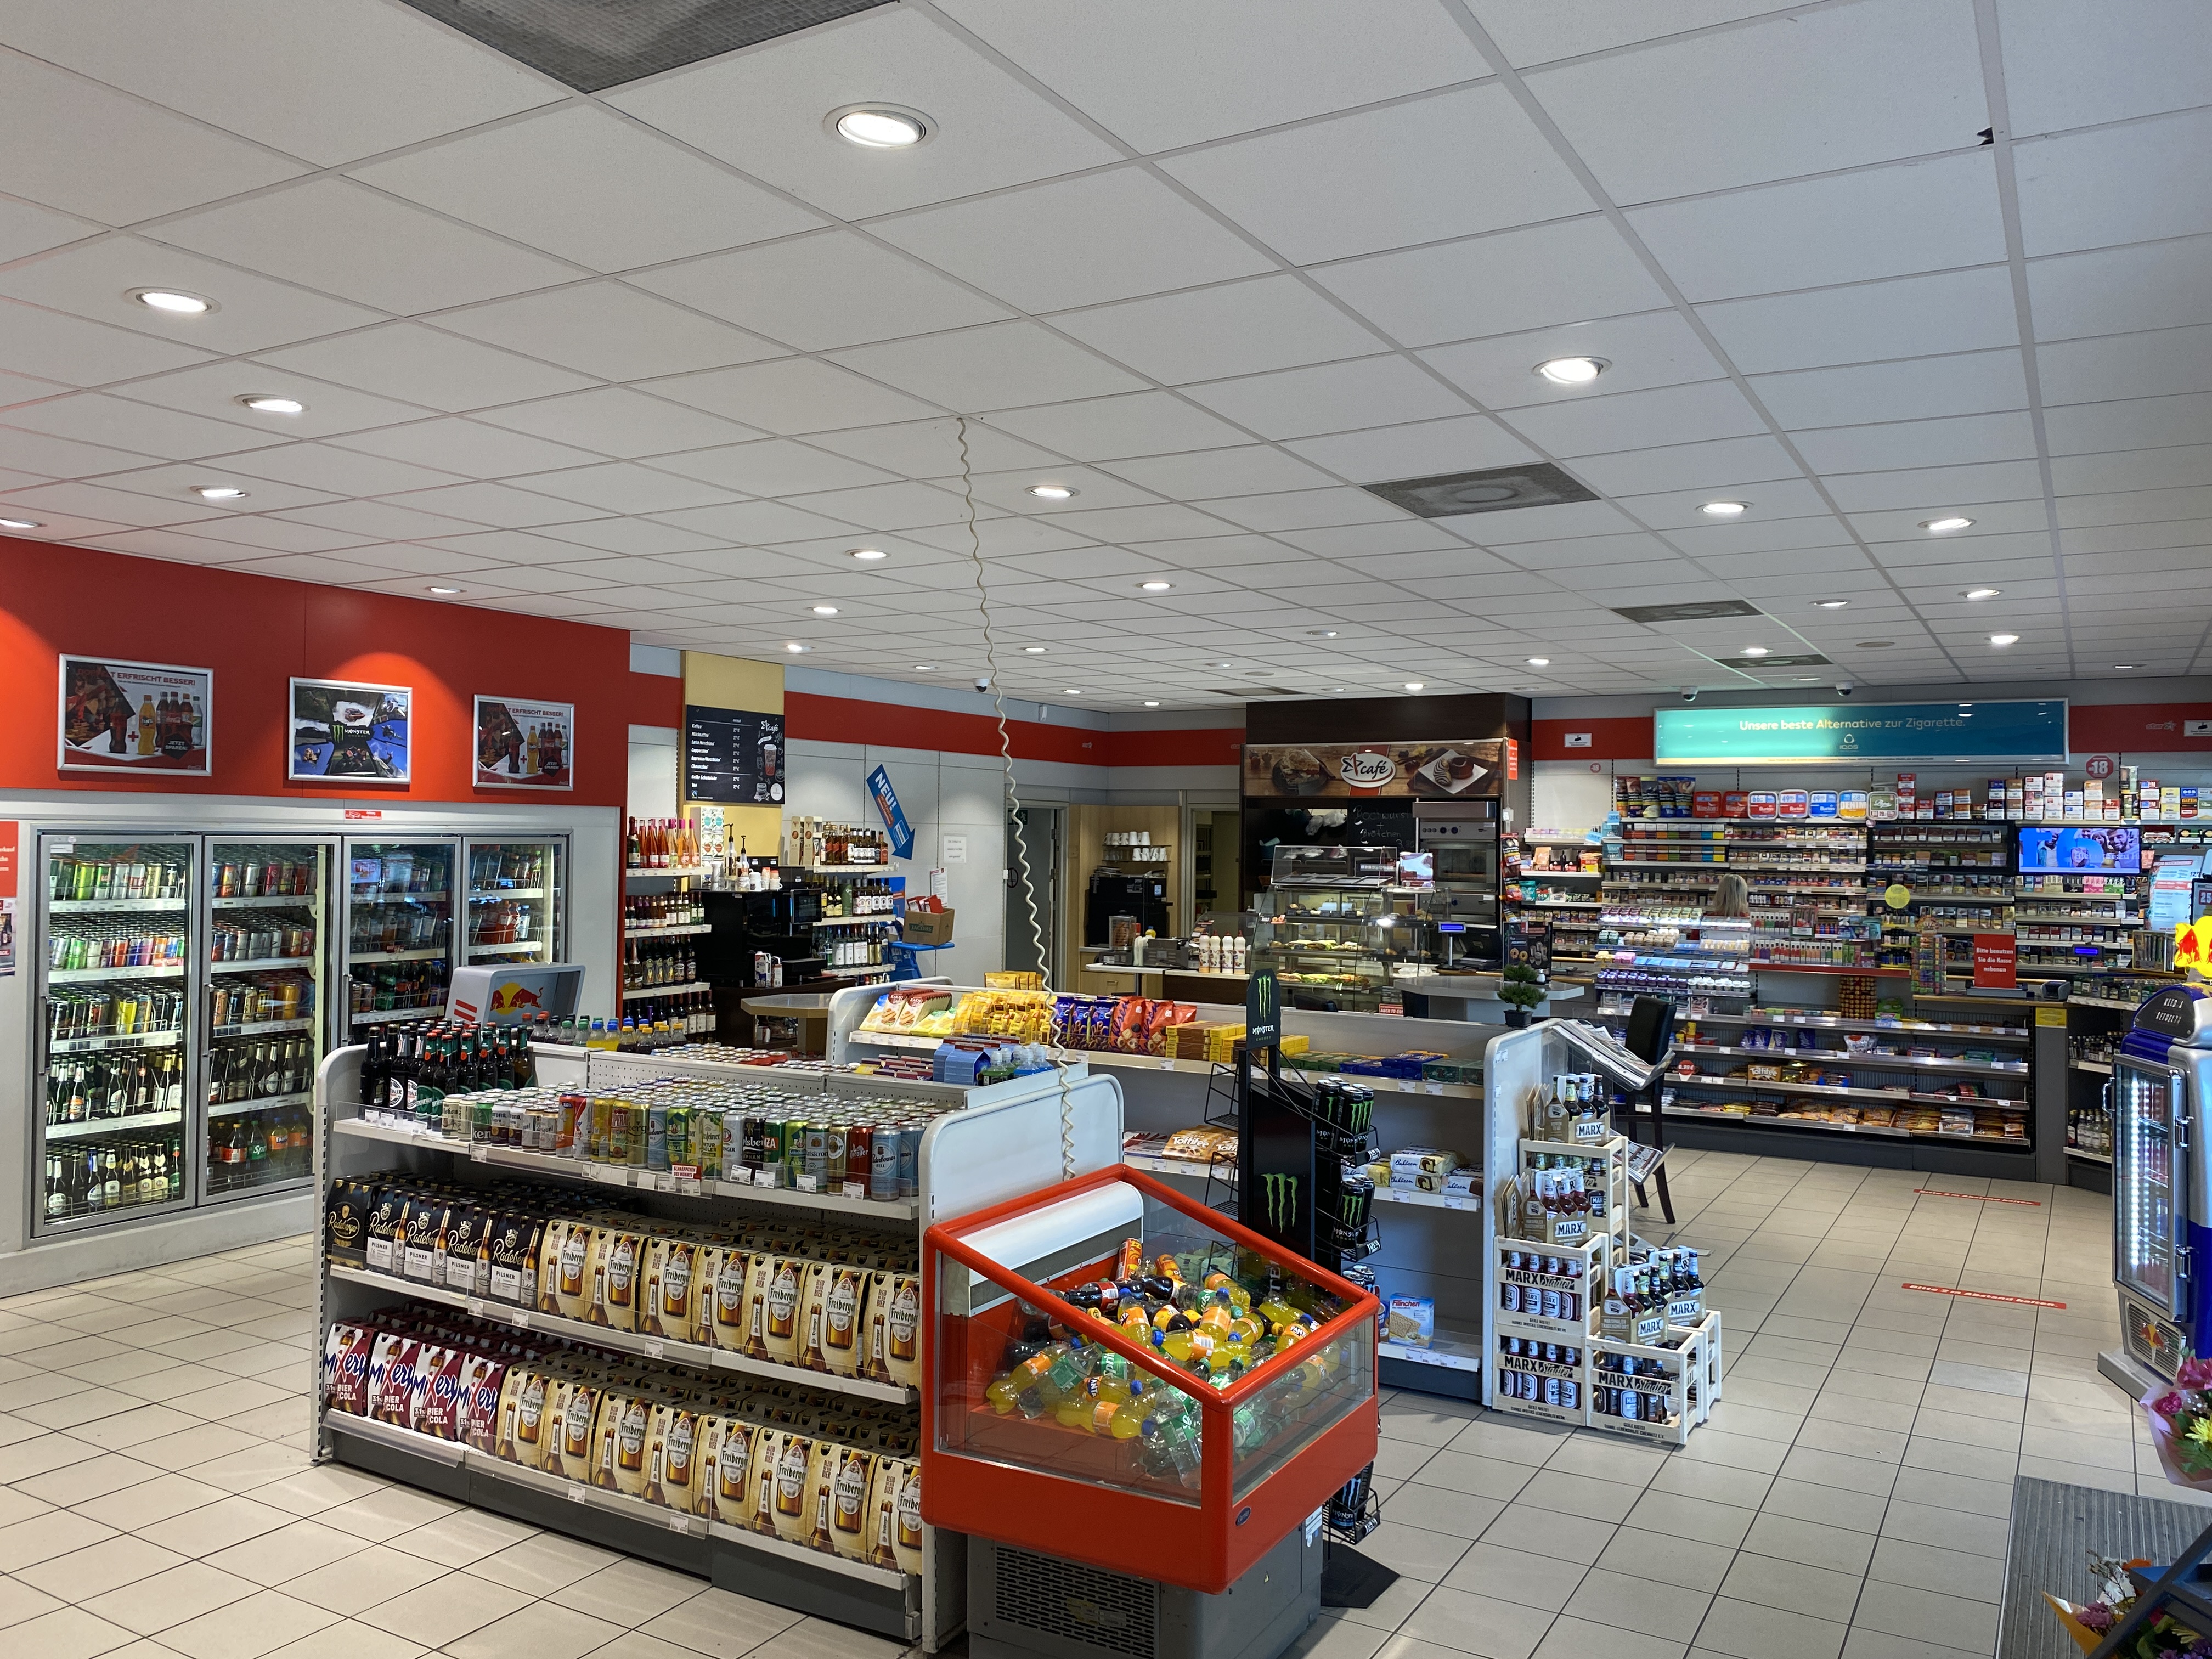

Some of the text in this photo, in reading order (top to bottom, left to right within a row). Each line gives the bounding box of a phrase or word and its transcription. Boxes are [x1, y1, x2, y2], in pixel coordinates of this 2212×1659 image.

[117, 673, 162, 684] ERFRISCHT
[163, 677, 195, 686] BESSER!
[1740, 718, 1966, 731] Unsere beste Alternative zur Zigarette.
[874, 772, 898, 811] NEU!
[1750, 1067, 1778, 1076] Toffifee
[1578, 1124, 1601, 1136] MARX
[1172, 1136, 1210, 1148] Toffifee
[1395, 1159, 1418, 1169] Bahlsen
[1391, 1176, 1414, 1185] Bahlsen
[329, 1211, 360, 1238] Radeberger
[1558, 1222, 1583, 1235] MARX
[371, 1242, 388, 1250] PILSNER
[409, 1251, 428, 1260] PILSNER
[451, 1261, 470, 1270] PILSNER
[496, 1270, 516, 1279] PILSNER
[1506, 1269, 1539, 1285] MARX
[1909, 1284, 1939, 1293] Bitte
[1963, 1292, 2015, 1301] Abstand
[2016, 1299, 2058, 1307] halten.
[828, 1296, 856, 1314] Freiberger
[1392, 1299, 1420, 1307] Filinchen
[1671, 1302, 1696, 1316] MARX
[891, 1307, 918, 1324] Freiberger
[1640, 1319, 1661, 1335] MARX
[1505, 1355, 1538, 1373] MARX
[1599, 1372, 1633, 1389] MARX
[337, 1384, 352, 1392] BIER
[384, 1395, 399, 1404] BIER
[427, 1407, 443, 1416] BIER
[471, 1419, 485, 1428] BIER
